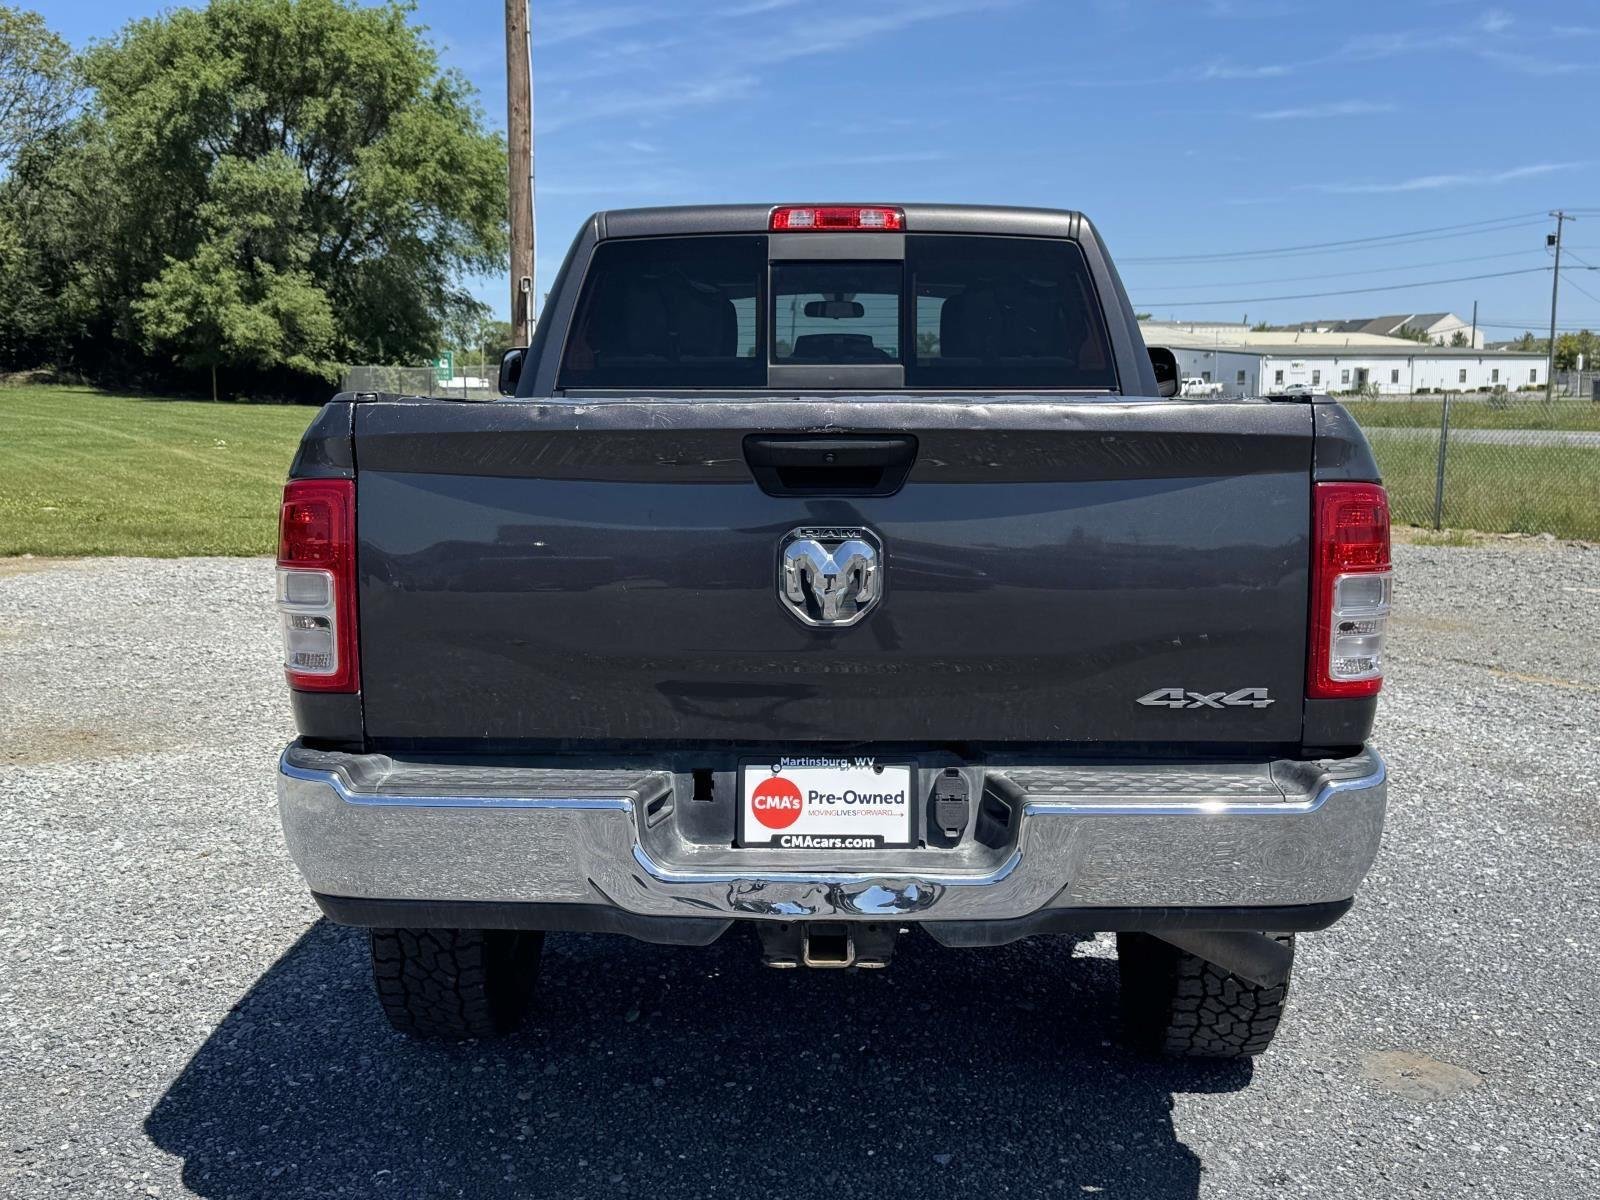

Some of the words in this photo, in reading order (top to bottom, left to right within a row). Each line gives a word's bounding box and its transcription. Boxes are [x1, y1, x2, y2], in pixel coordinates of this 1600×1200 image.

[799, 528, 861, 538] RAM
[780, 757, 851, 768] Martinsburg,
[854, 757, 876, 767] WV
[754, 796, 801, 810] CMA's
[808, 790, 905, 805] Pre-Owned
[780, 835, 876, 848] CMAcars.com
